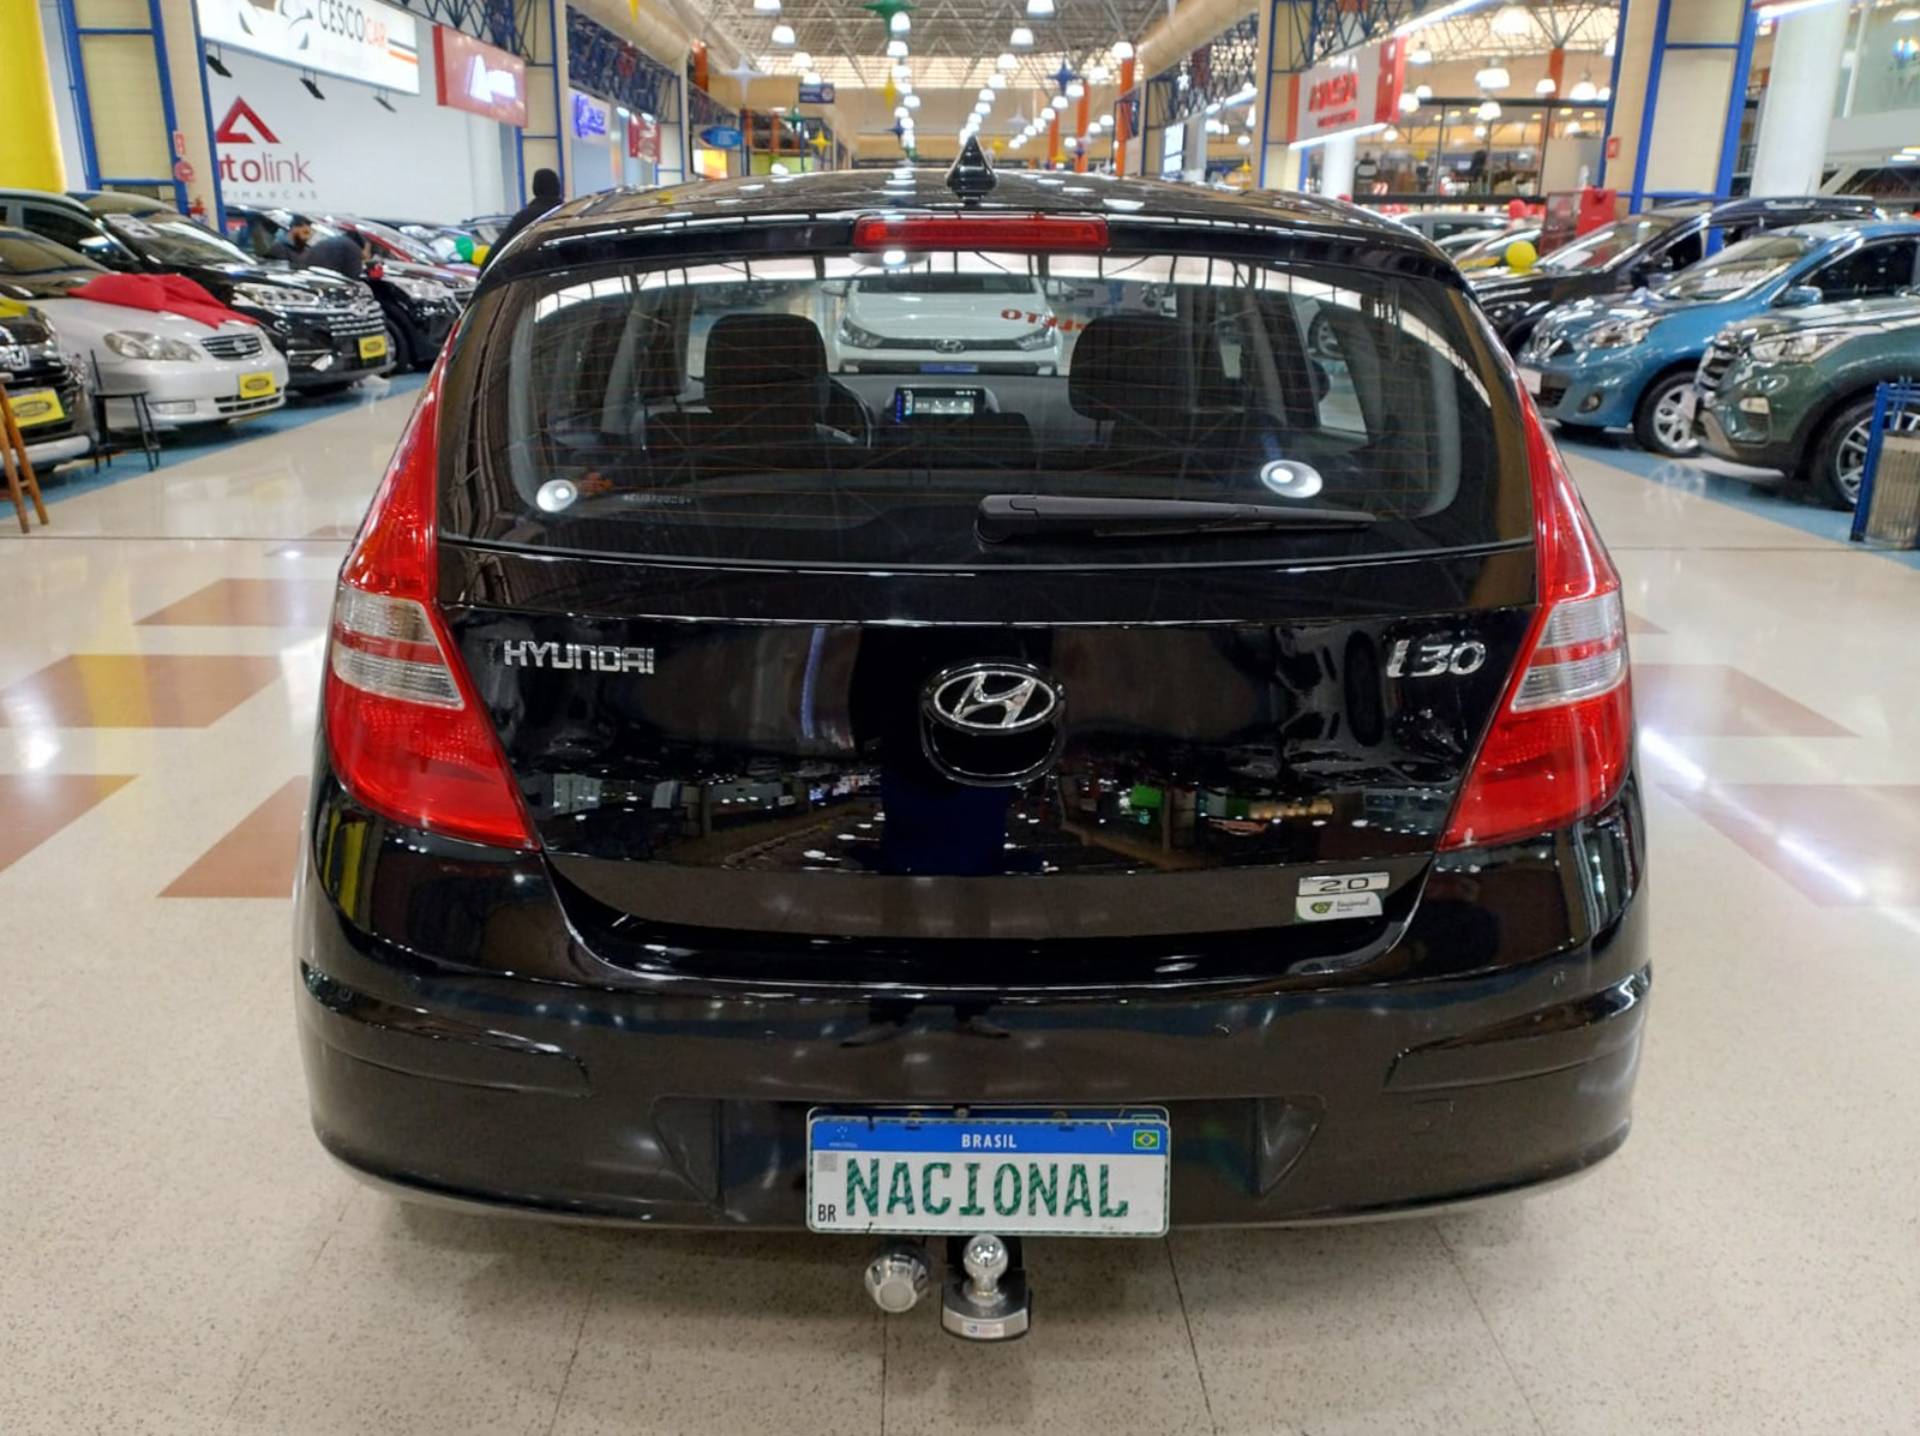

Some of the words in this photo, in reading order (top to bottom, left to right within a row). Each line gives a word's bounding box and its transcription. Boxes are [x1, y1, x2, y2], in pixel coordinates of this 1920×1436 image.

[504, 640, 655, 674] HYUNDAI
[961, 1133, 1017, 1149] BRASIL
[846, 1158, 1129, 1217] NACIONAL
[817, 1204, 837, 1222] BR
